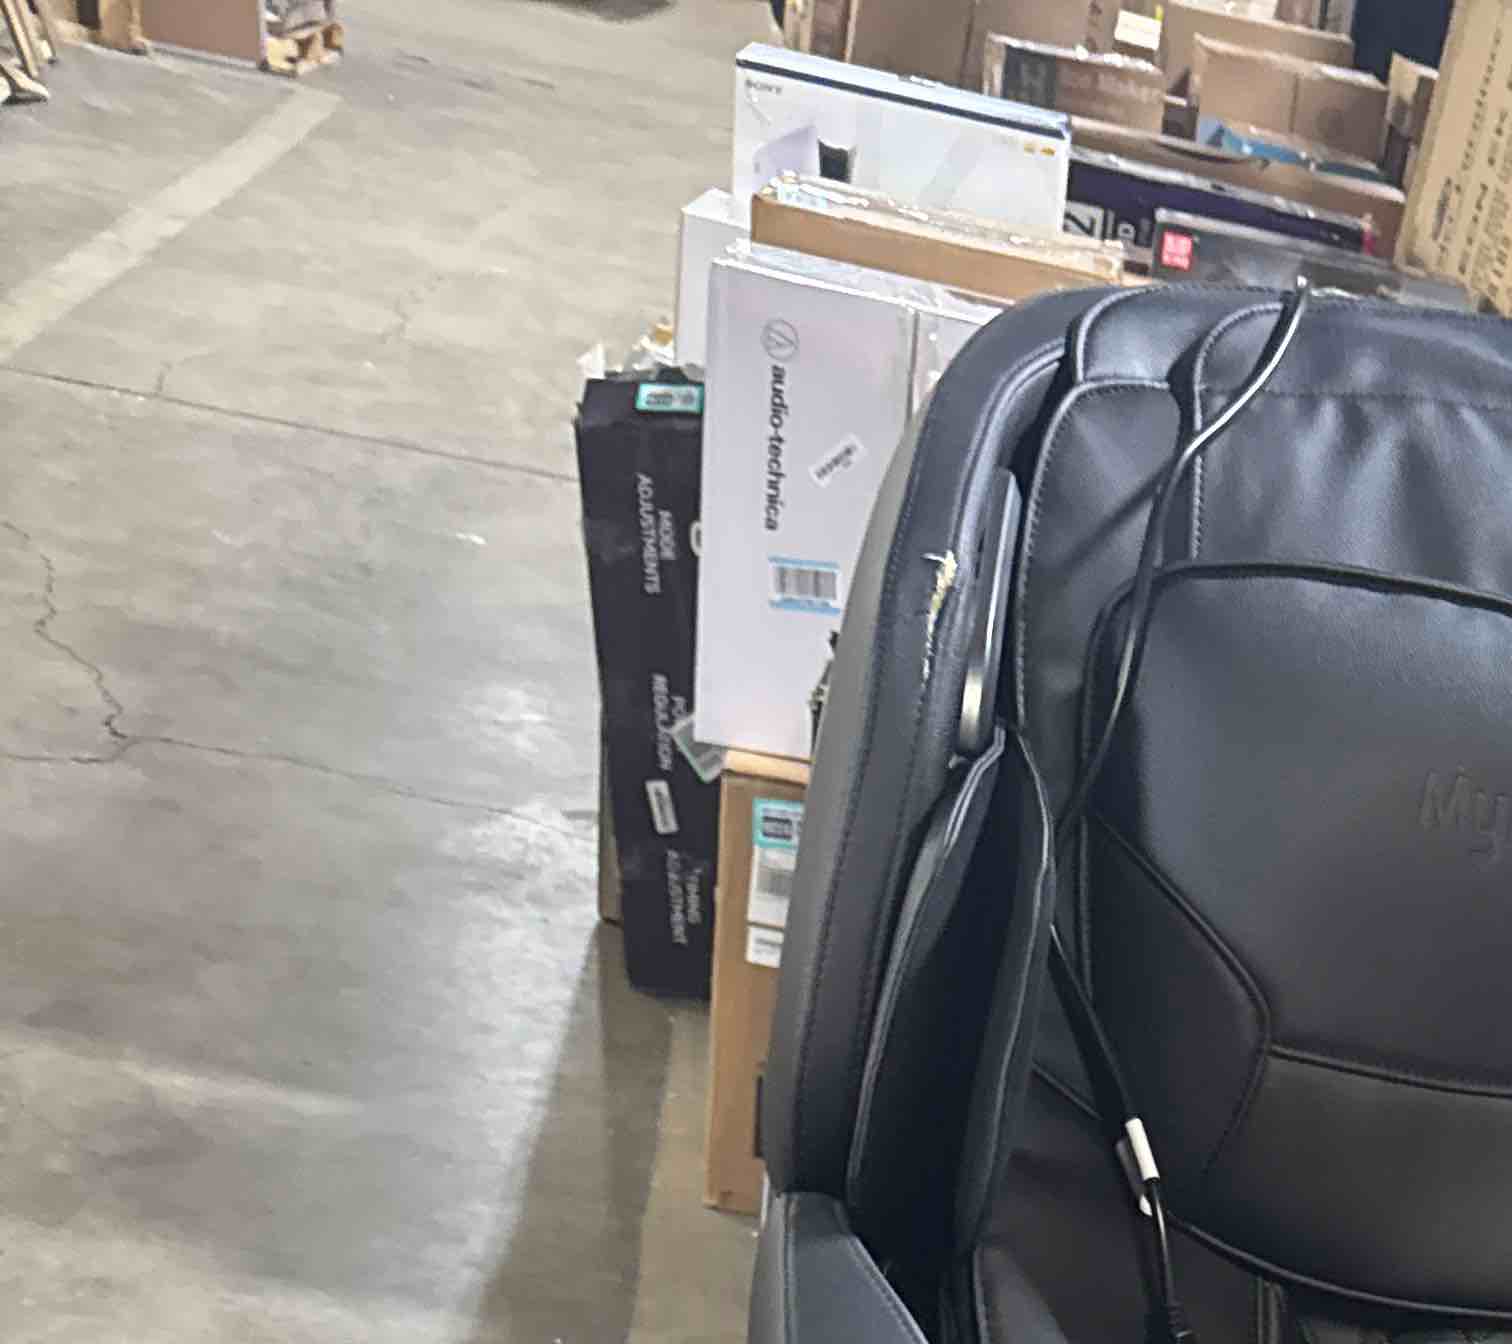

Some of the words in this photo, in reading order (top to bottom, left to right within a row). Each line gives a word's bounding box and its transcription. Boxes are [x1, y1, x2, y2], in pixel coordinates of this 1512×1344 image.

[764, 364, 789, 531] audio-technica
[635, 471, 661, 595] ADJUSTMENTS
[658, 508, 676, 561] MODE
